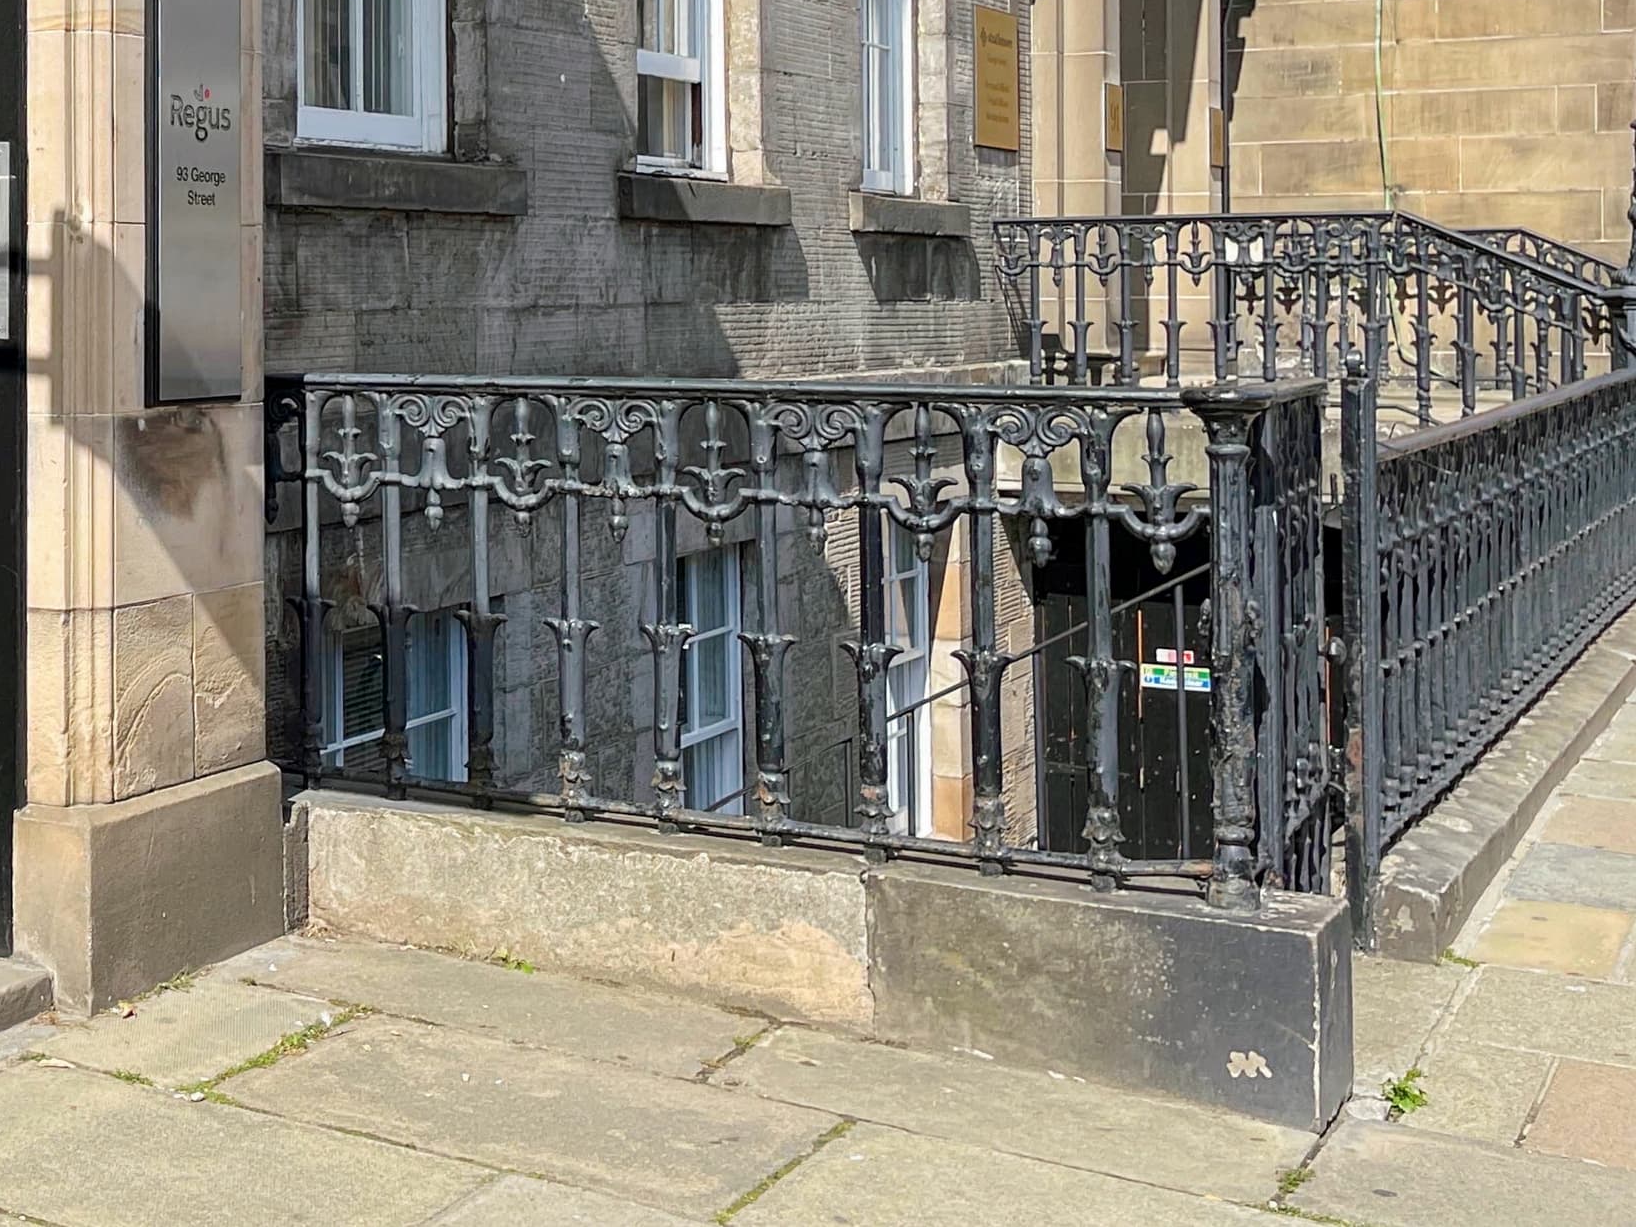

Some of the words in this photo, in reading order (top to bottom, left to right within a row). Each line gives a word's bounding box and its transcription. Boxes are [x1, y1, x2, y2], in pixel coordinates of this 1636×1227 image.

[170, 93, 232, 142] Regus
[191, 167, 226, 187] George
[187, 190, 216, 206] Street
